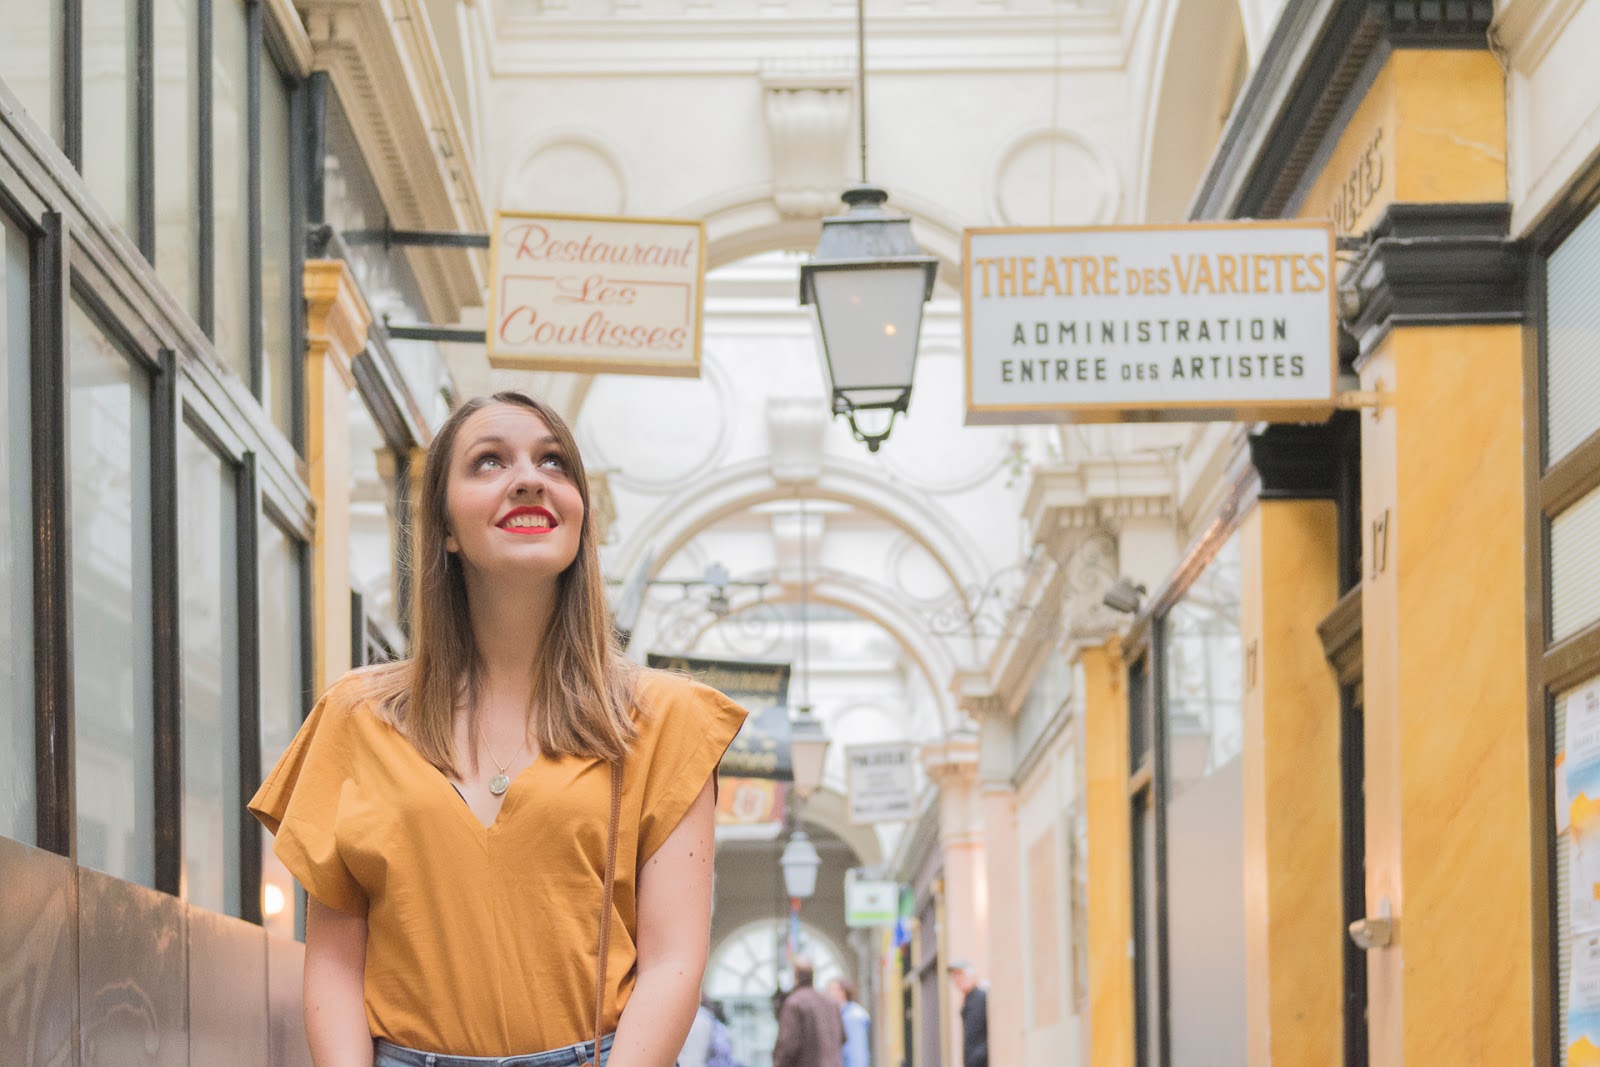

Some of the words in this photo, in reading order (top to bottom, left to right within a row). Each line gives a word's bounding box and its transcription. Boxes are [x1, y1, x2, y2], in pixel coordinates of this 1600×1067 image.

[504, 224, 694, 268] Restaurant
[553, 275, 638, 305] Les
[976, 256, 1120, 298] THEATRE
[1126, 268, 1171, 296] DES
[1172, 253, 1326, 294] VARIETES
[500, 305, 687, 350] Coulisses
[1013, 318, 1287, 345] ADMINISTRATION
[1001, 358, 1107, 383] ENTREE
[1121, 363, 1159, 381] DES
[1172, 355, 1305, 380] ARTISTES
